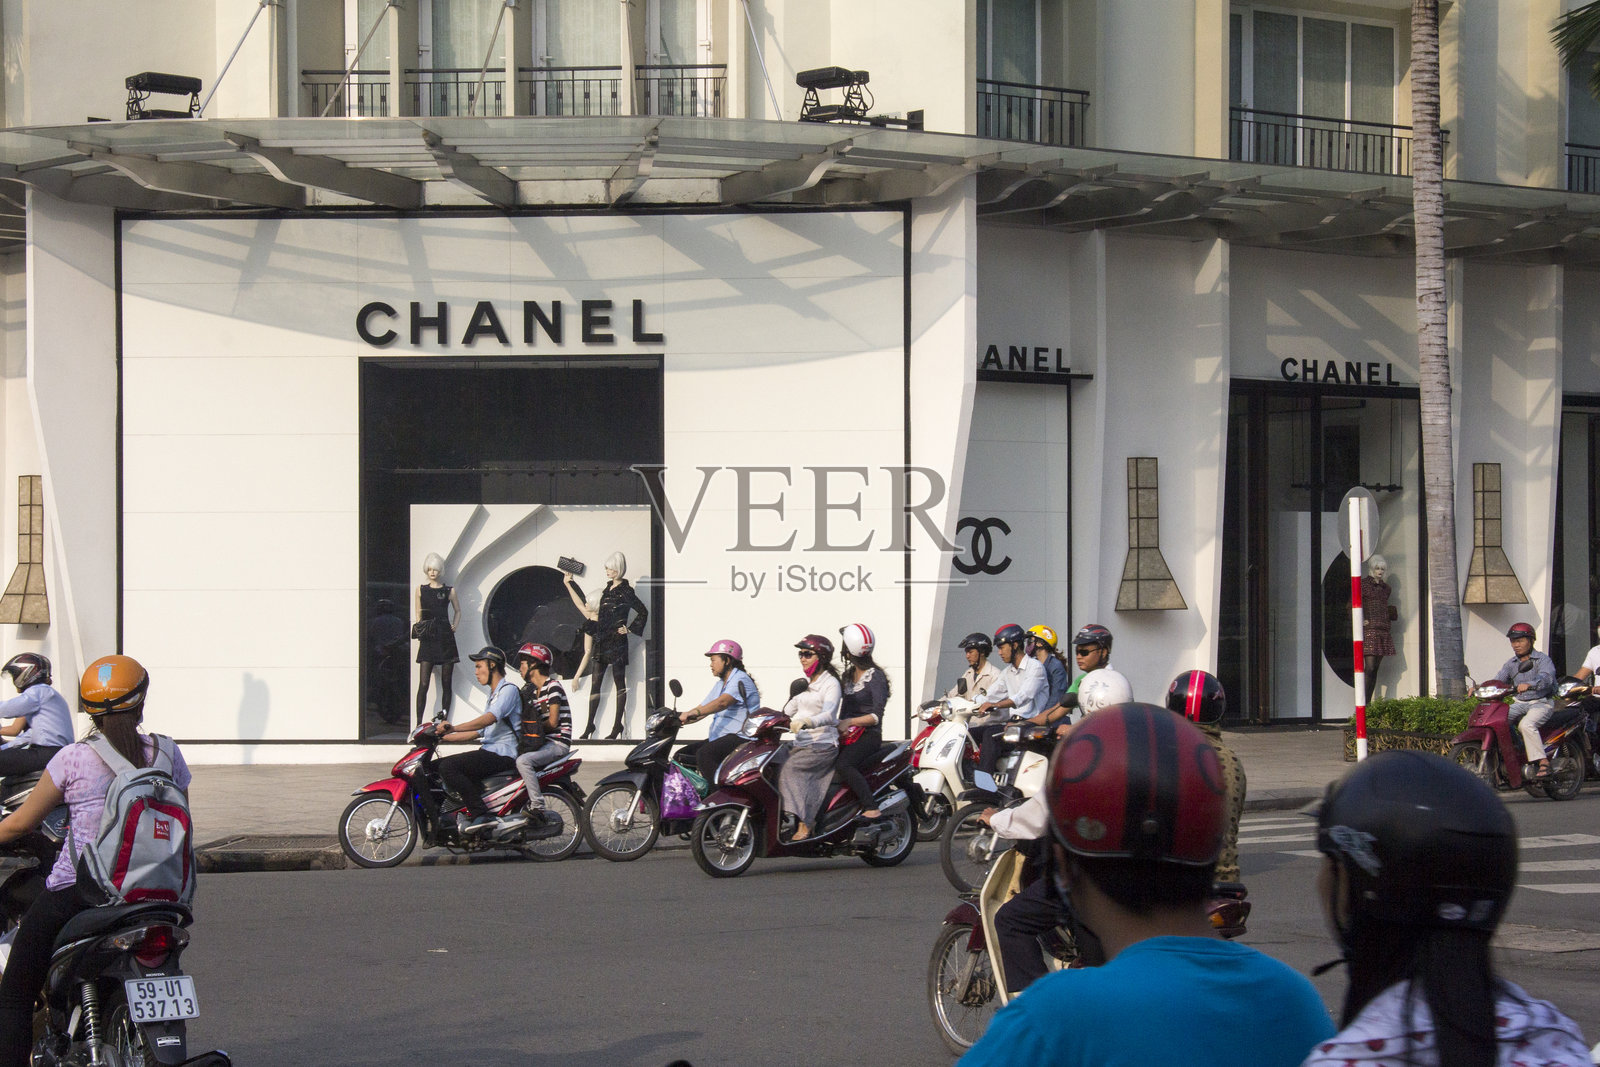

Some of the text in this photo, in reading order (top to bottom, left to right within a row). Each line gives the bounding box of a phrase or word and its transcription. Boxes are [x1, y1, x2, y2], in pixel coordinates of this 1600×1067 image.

[356, 299, 664, 346] CHANEL
[1281, 357, 1400, 387] CHANEL
[136, 980, 183, 999] 59-U1
[134, 998, 195, 1019] 537.13
